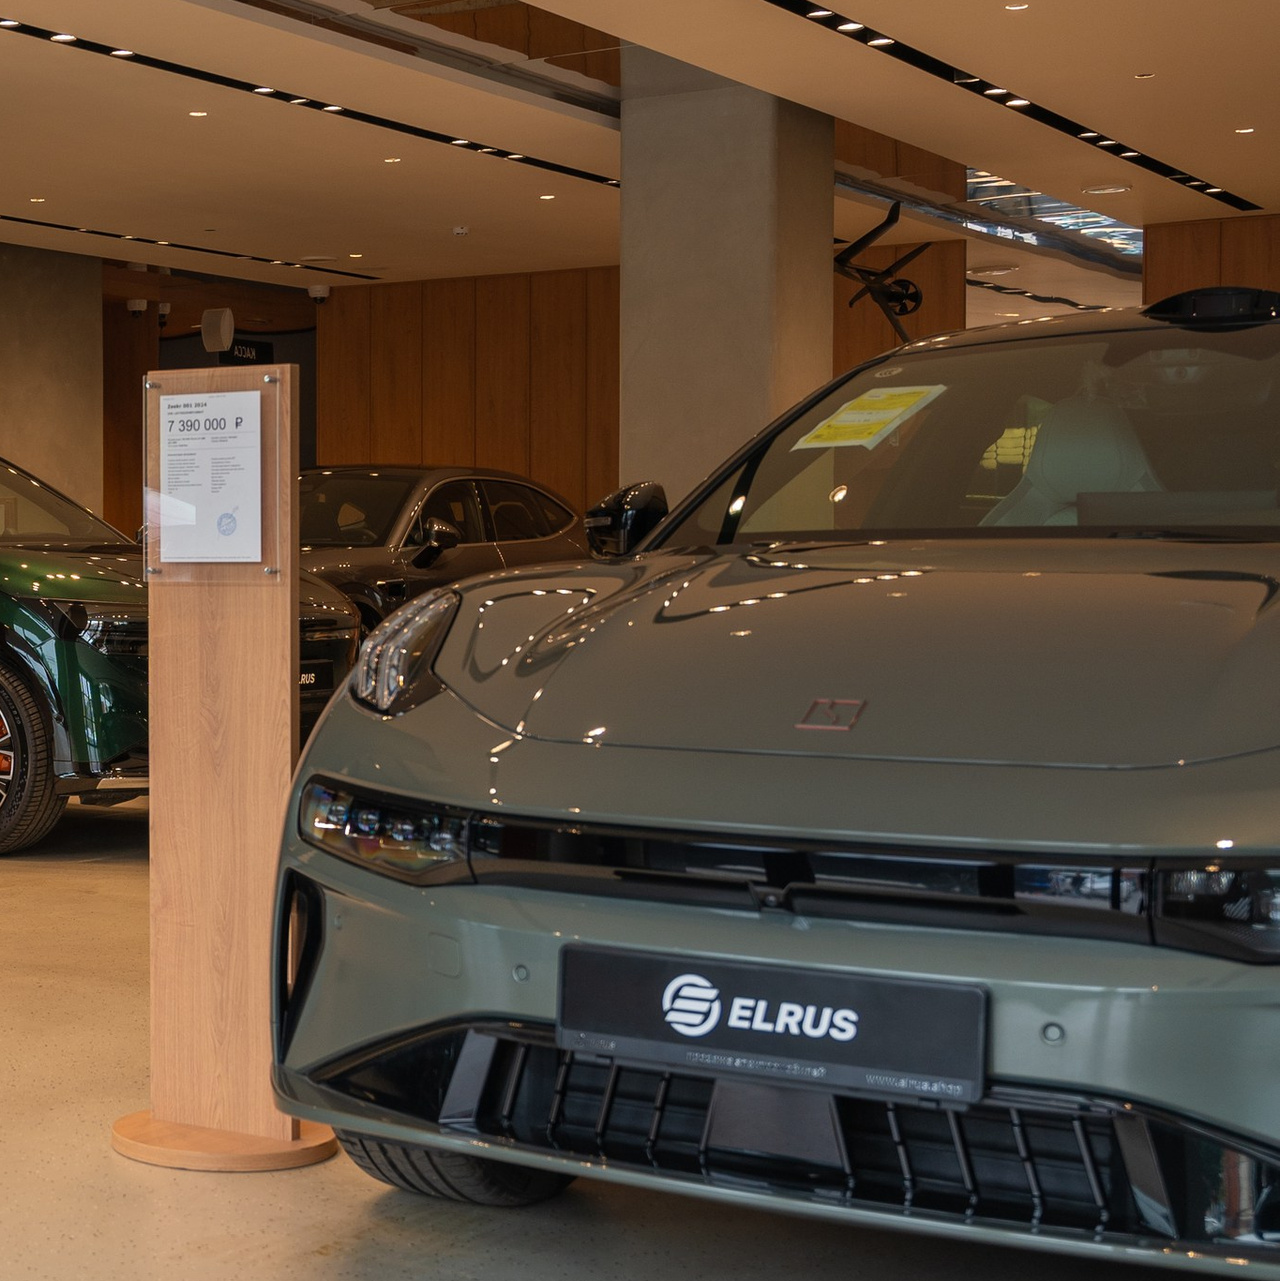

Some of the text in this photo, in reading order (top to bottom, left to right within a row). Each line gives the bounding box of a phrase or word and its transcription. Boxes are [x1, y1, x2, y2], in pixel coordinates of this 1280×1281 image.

[168, 420, 175, 432] 7
[178, 419, 200, 432] 390
[204, 418, 226, 431] 000
[298, 673, 315, 684] RUS
[728, 996, 859, 1042] ELRUS
